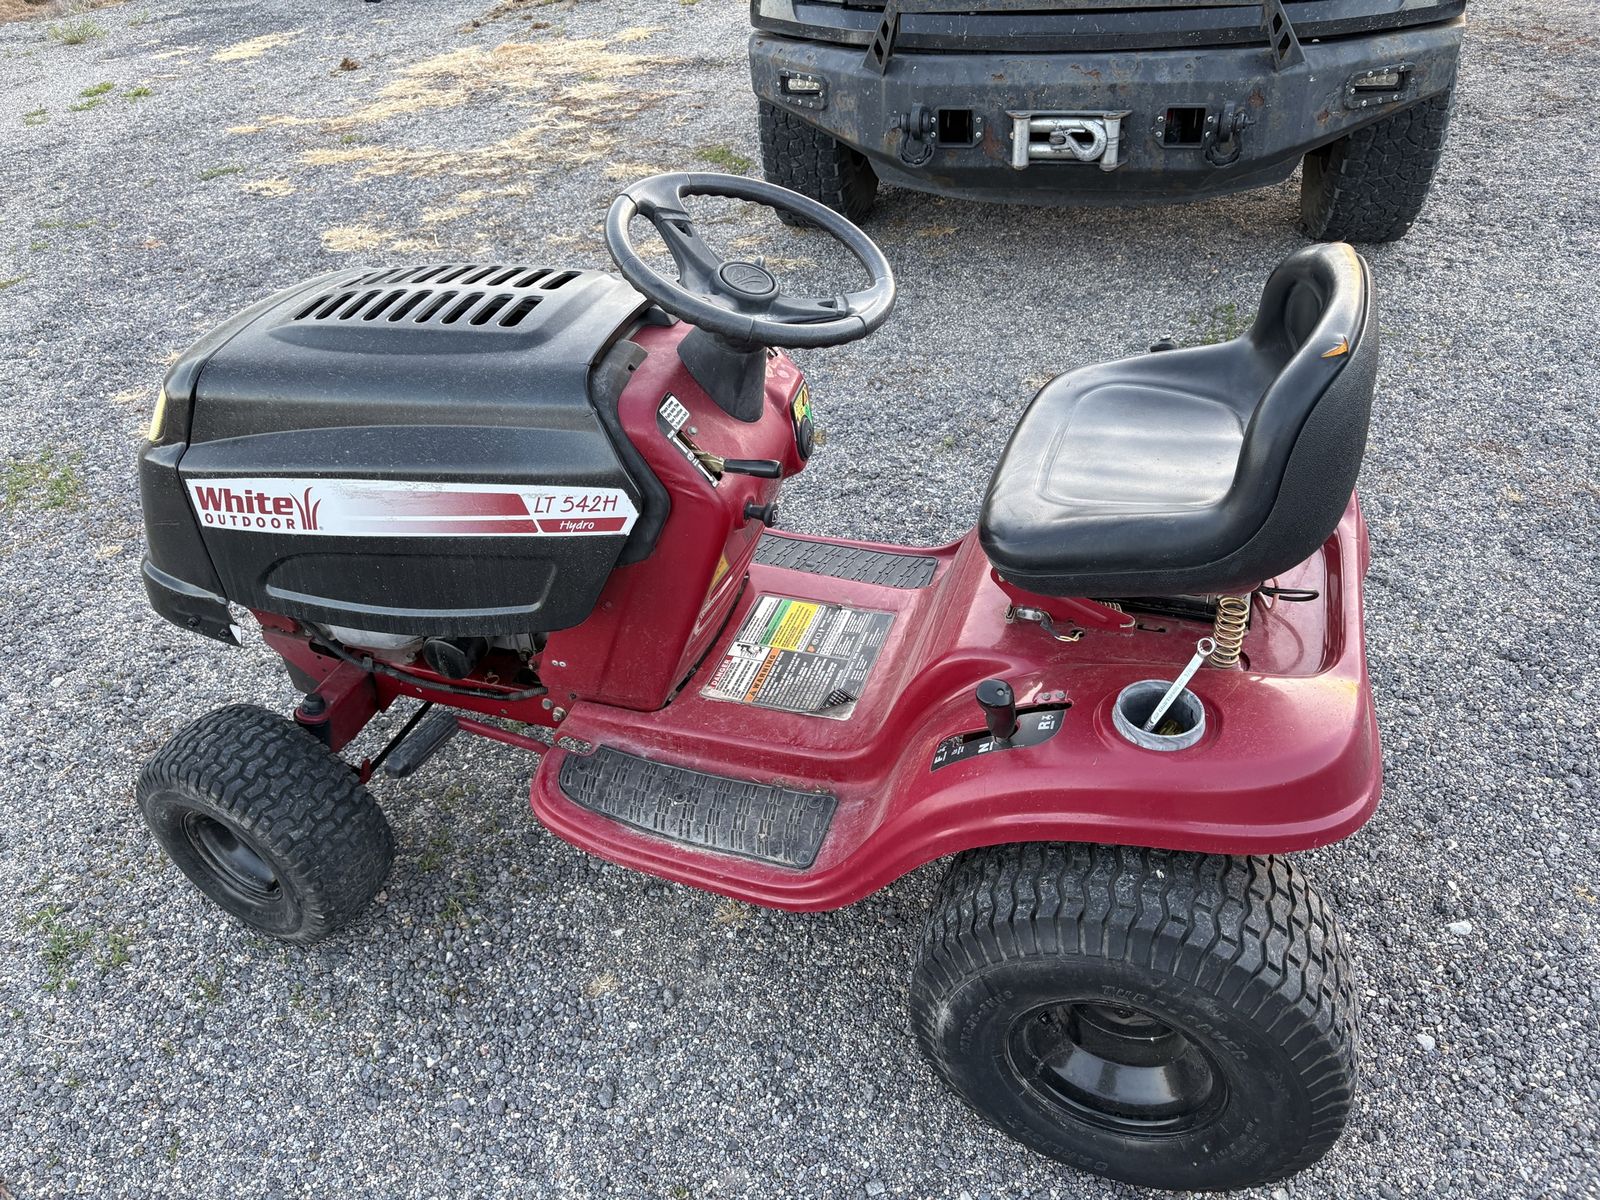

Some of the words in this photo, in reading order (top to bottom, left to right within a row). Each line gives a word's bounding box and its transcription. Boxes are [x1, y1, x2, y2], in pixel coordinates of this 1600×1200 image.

[195, 486, 293, 516] White
[534, 496, 556, 513] LT
[560, 494, 618, 513] 542H
[204, 513, 295, 529] OUTDOOR
[560, 520, 595, 533] Hydro
[711, 659, 730, 686] DANGER
[755, 654, 776, 689] WARNING
[1037, 721, 1051, 730] R
[977, 742, 989, 753] N
